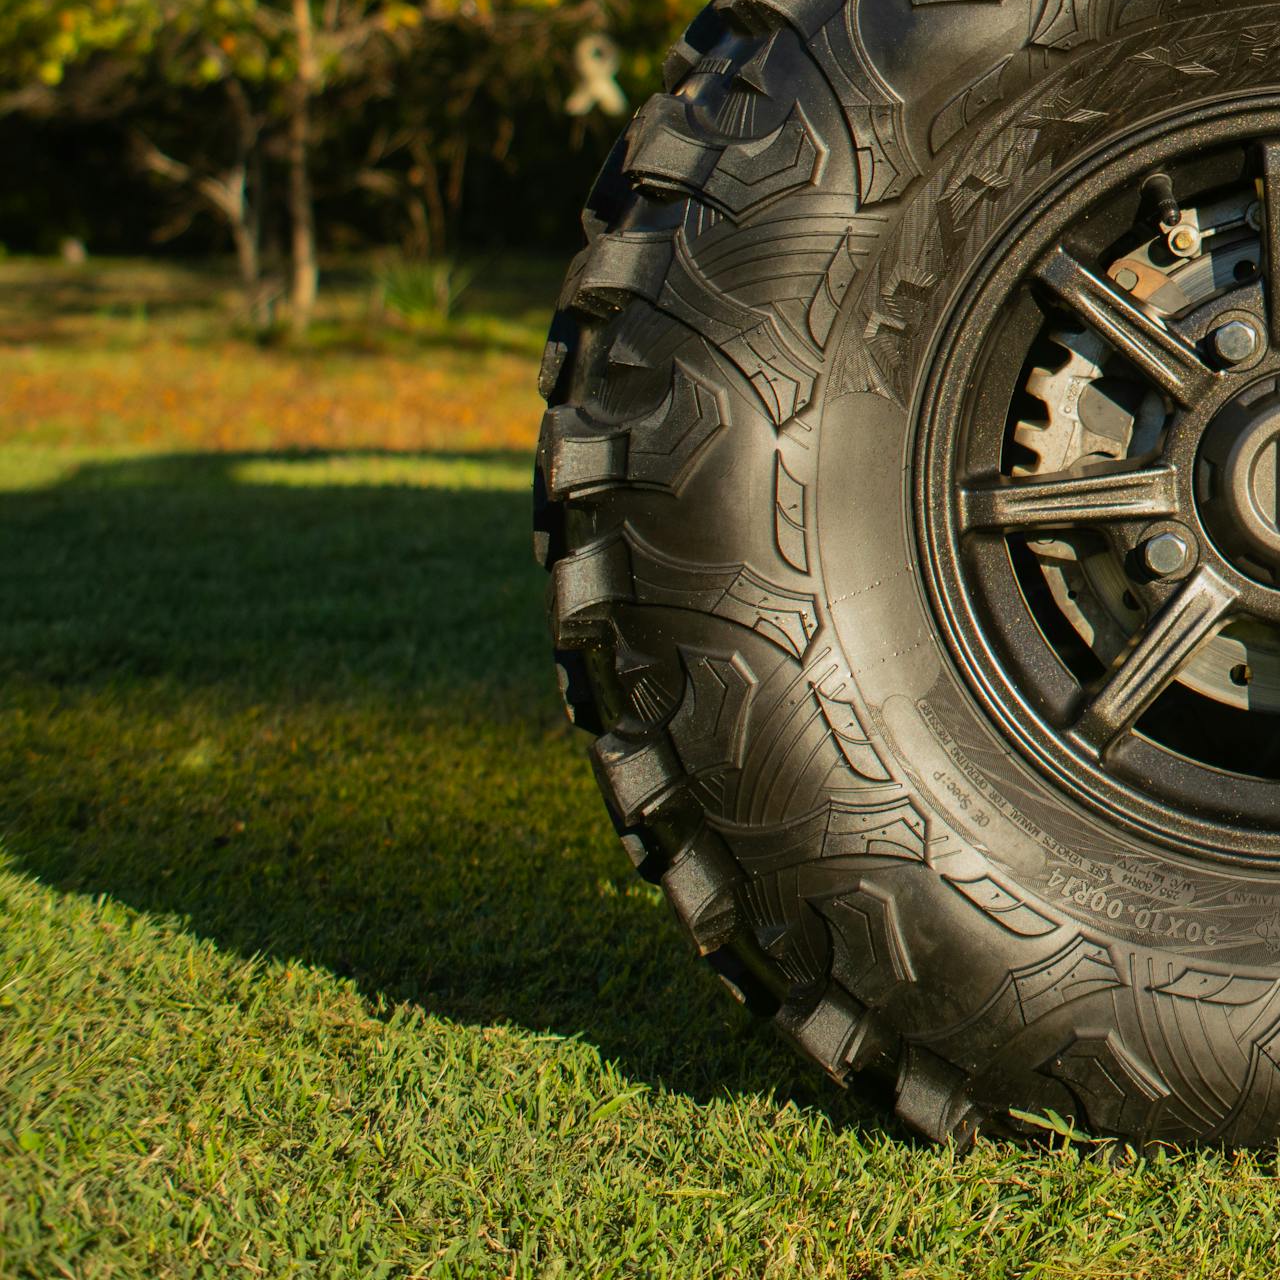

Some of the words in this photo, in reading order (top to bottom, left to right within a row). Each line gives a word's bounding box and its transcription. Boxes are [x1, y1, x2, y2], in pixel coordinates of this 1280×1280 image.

[916, 700, 952, 746] PRESSURE
[947, 745, 990, 791] OPERATING
[986, 788, 1008, 809] FOR
[970, 808, 992, 829] OE
[1006, 806, 1042, 838] MANUAL
[1086, 862, 1106, 879] SEE
[1047, 865, 1219, 946] 30X10.00R14
[1231, 890, 1275, 907] TAIWAN
